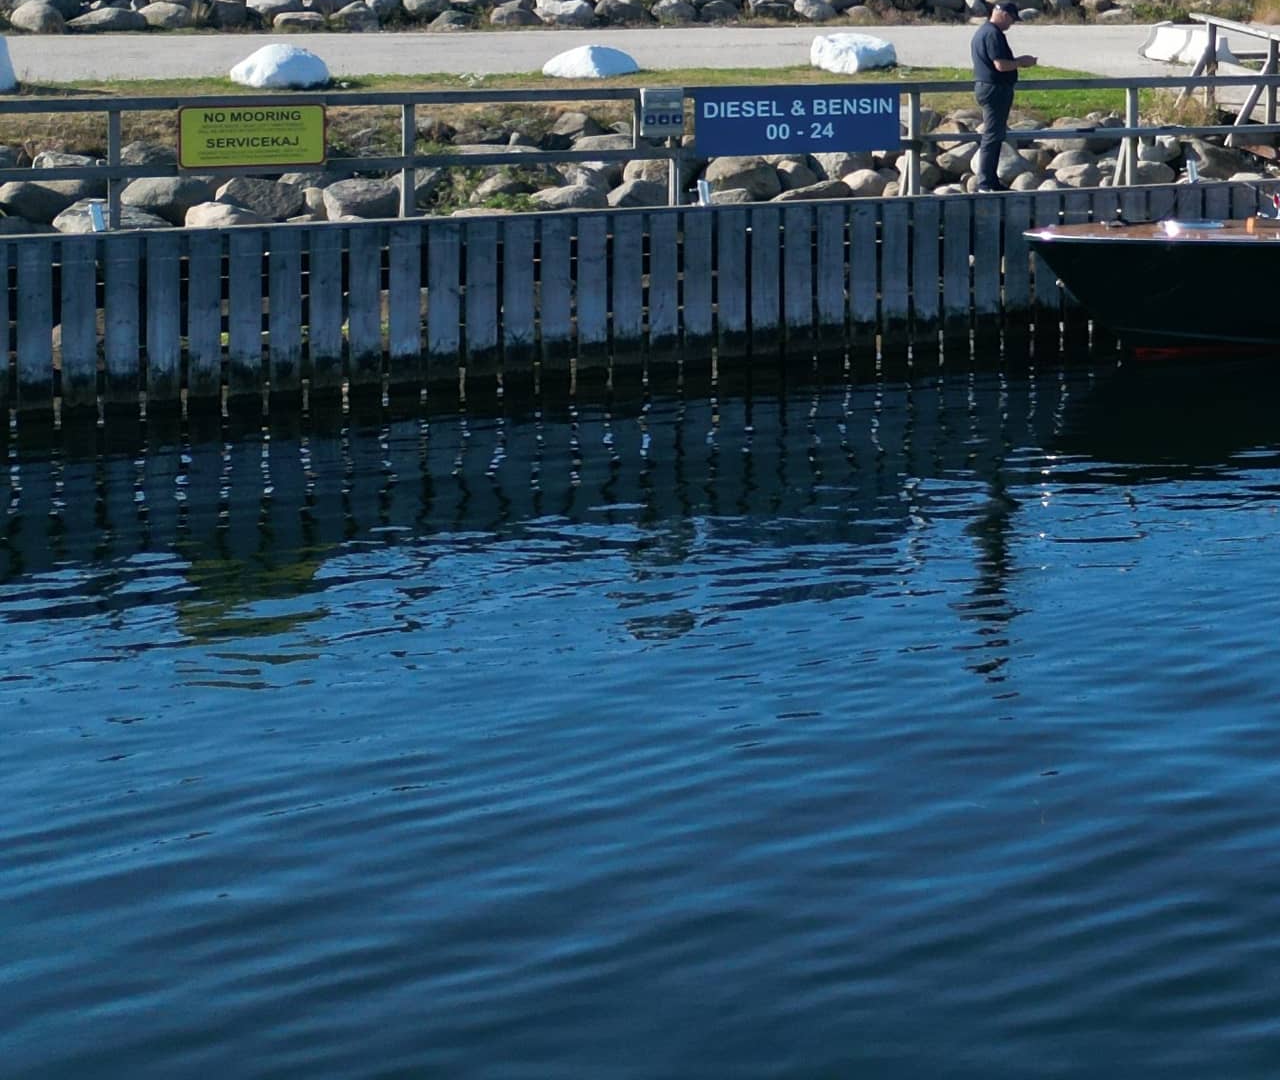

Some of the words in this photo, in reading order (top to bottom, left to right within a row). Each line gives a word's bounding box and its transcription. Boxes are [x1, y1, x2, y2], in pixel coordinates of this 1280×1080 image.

[704, 101, 784, 118] DIESEL
[791, 101, 805, 116] &
[813, 98, 892, 115] BENSIN
[203, 112, 226, 123] NO
[230, 111, 302, 122] MOORING
[766, 124, 789, 140] 00
[810, 123, 834, 139] 24
[206, 136, 300, 149] SERVICEKAJ
